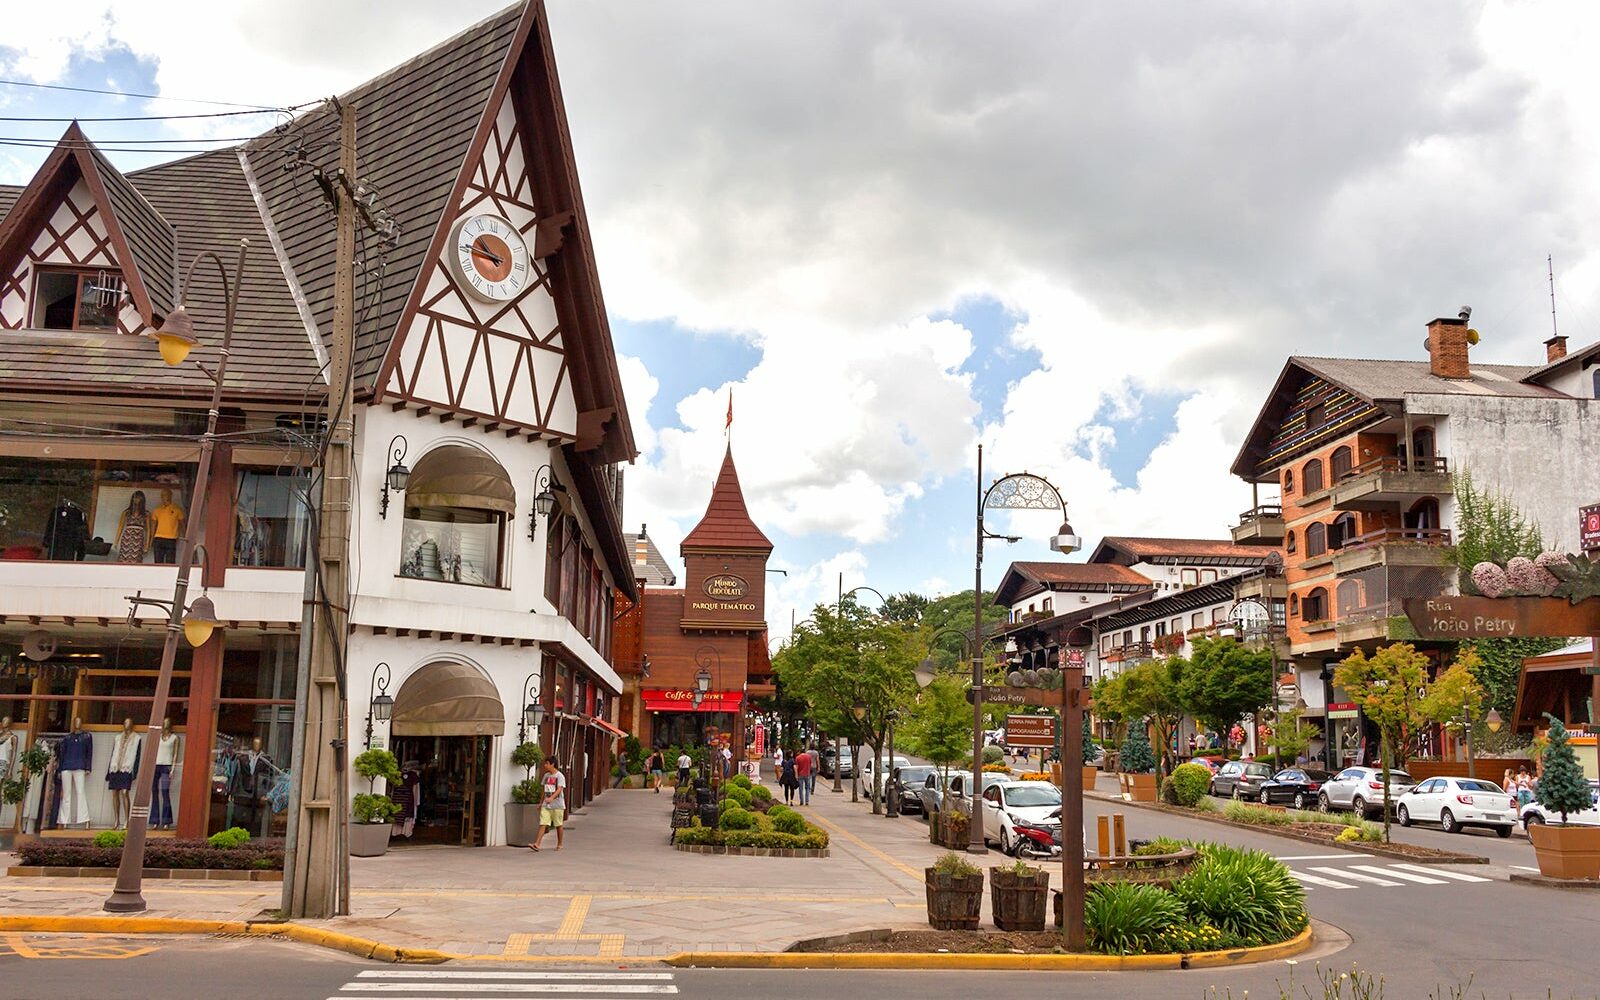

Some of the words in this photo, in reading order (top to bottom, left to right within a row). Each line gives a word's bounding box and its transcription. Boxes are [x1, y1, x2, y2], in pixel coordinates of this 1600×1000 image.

[692, 602, 718, 611] PARQUE
[720, 602, 756, 611] TEMÁTICO
[1426, 601, 1451, 612] Rua
[1429, 616, 1470, 632] João
[1474, 616, 1516, 634] Petry
[665, 691, 686, 700] Coffe
[686, 692, 693, 700] &
[1007, 695, 1026, 703] Petry
